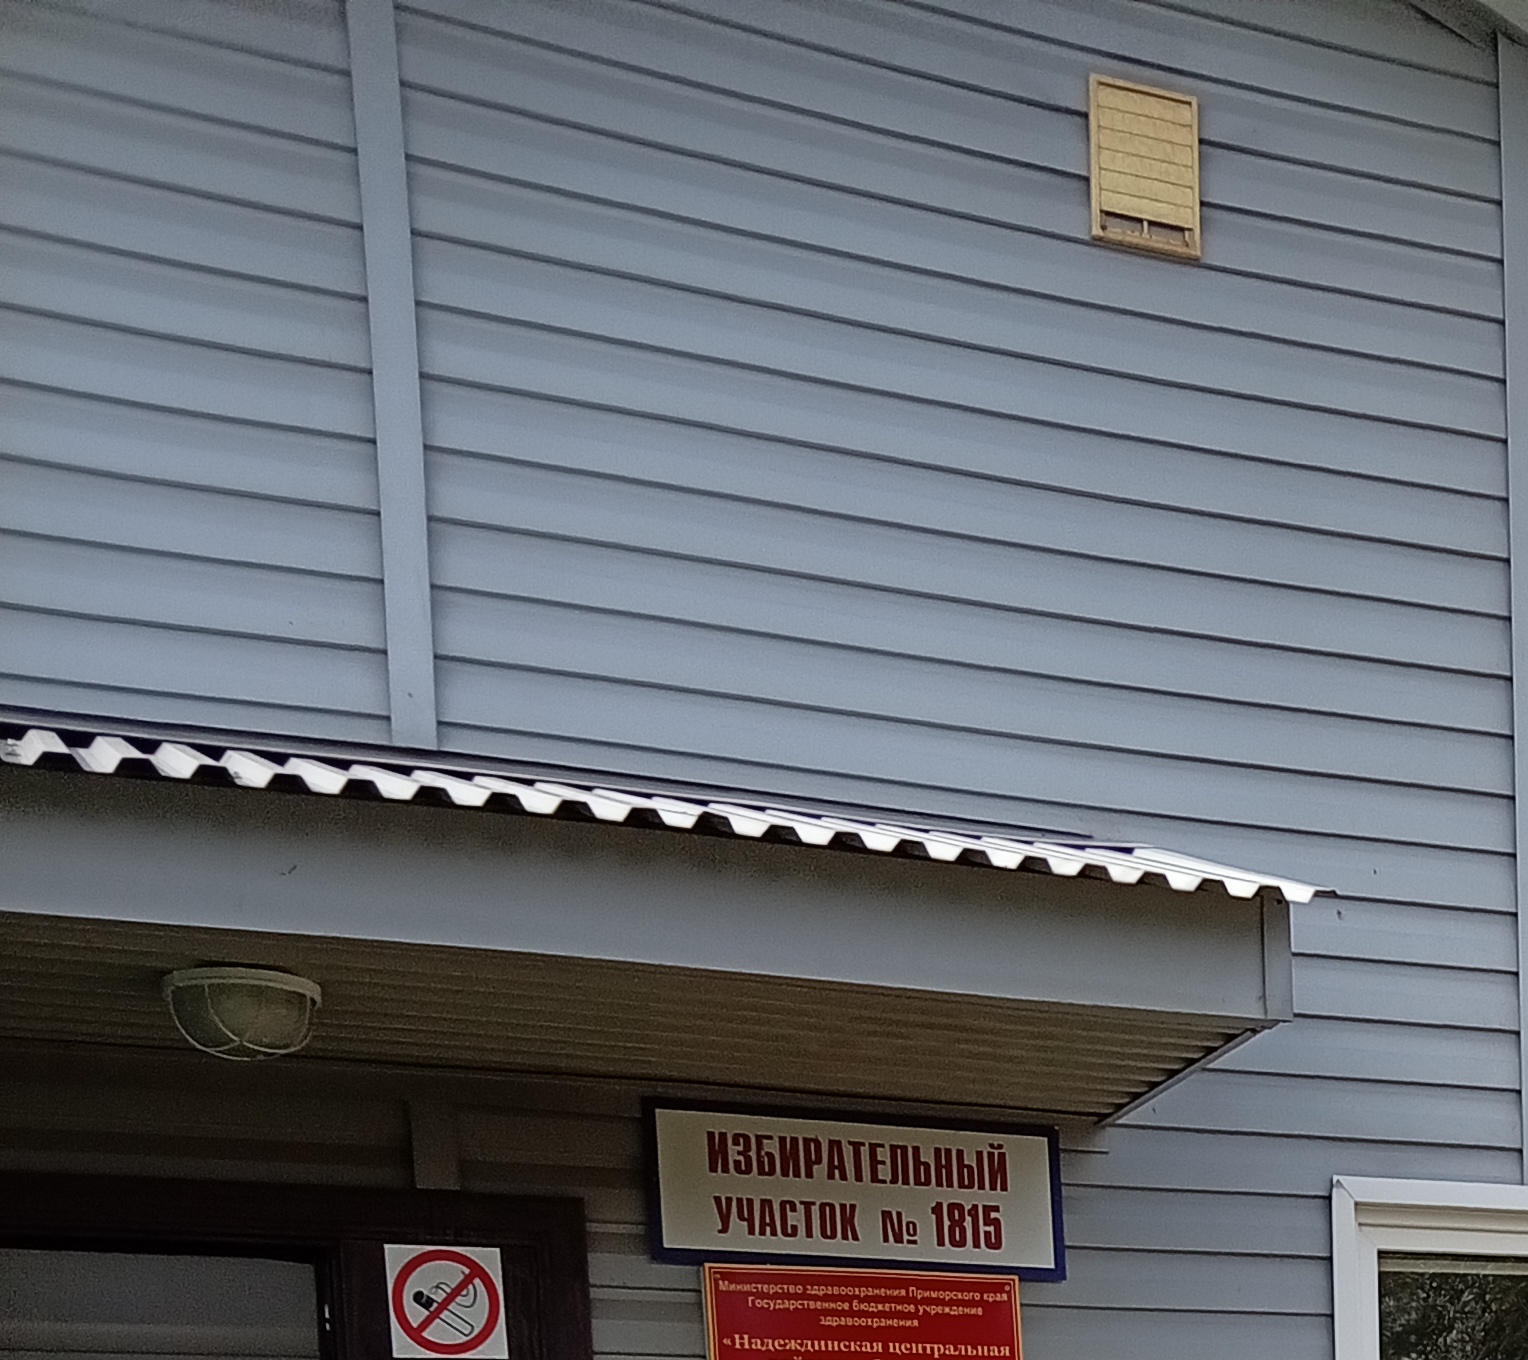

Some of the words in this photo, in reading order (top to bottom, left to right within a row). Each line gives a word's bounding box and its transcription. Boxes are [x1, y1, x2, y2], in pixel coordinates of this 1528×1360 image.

[706, 1129, 1009, 1193] ИЗБИРАТЕЛЬНЫЙ
[712, 1195, 860, 1242] УЧАСТОК
[881, 1209, 918, 1245] №
[931, 1200, 1003, 1251] 1815
[718, 1279, 803, 1295] Министерство
[805, 1284, 906, 1299] здравоохранения
[908, 1286, 981, 1302] Приморского
[983, 1291, 1008, 1303] края
[747, 1296, 850, 1312] Государственное
[852, 1299, 916, 1313] бюджетное
[917, 1303, 983, 1317] учреждение
[819, 1315, 919, 1329] здравоохранения
[722, 1333, 884, 1354] «Надеждинская
[888, 1340, 1011, 1359] центральная
